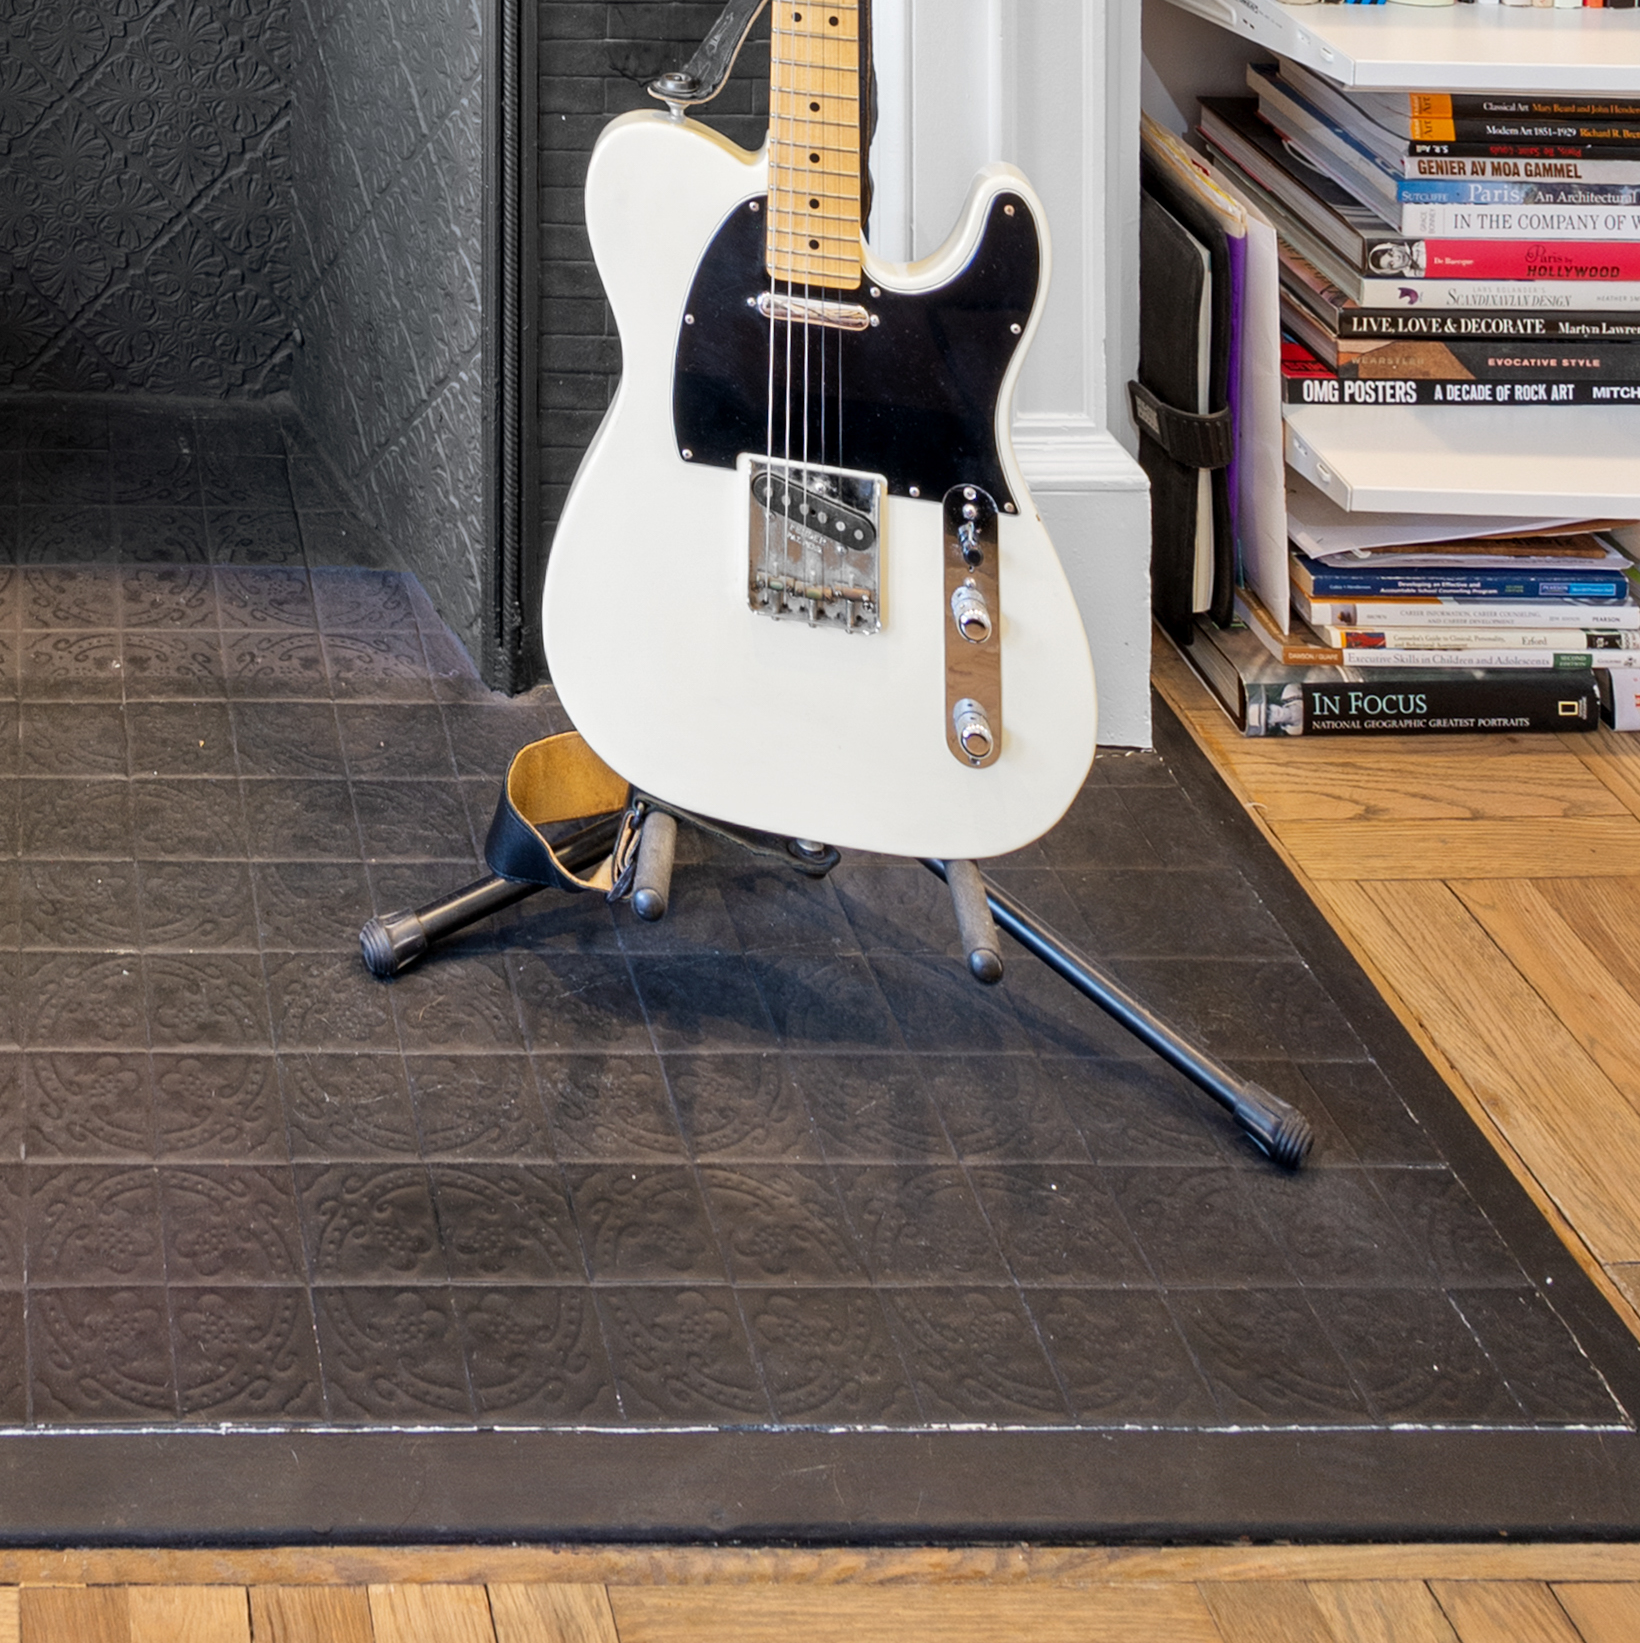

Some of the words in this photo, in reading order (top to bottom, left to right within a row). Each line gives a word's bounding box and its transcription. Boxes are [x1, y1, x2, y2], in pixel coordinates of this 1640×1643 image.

[1454, 214, 1471, 229] IN
[1478, 214, 1512, 230] THE
[1518, 214, 1600, 230] COMPANY
[1604, 216, 1626, 230] OF
[1526, 265, 1620, 278] HOLLYWOOD
[1487, 358, 1557, 366] EVOCATIVE
[1562, 358, 1600, 367] STYLE
[1302, 380, 1339, 403] OMG
[1344, 380, 1418, 403] POSTERS
[1434, 385, 1443, 400] A
[1446, 385, 1493, 400] DECADE
[1496, 385, 1510, 401] OF
[1514, 385, 1547, 400] ROCK
[1550, 384, 1575, 400] ART
[1522, 636, 1547, 646] Erford
[1312, 720, 1361, 730] NATIONAL
[1364, 718, 1427, 729] GEOGRAPHIC
[1429, 718, 1476, 728] GREATEST
[1477, 717, 1530, 728] PORTRAITS
